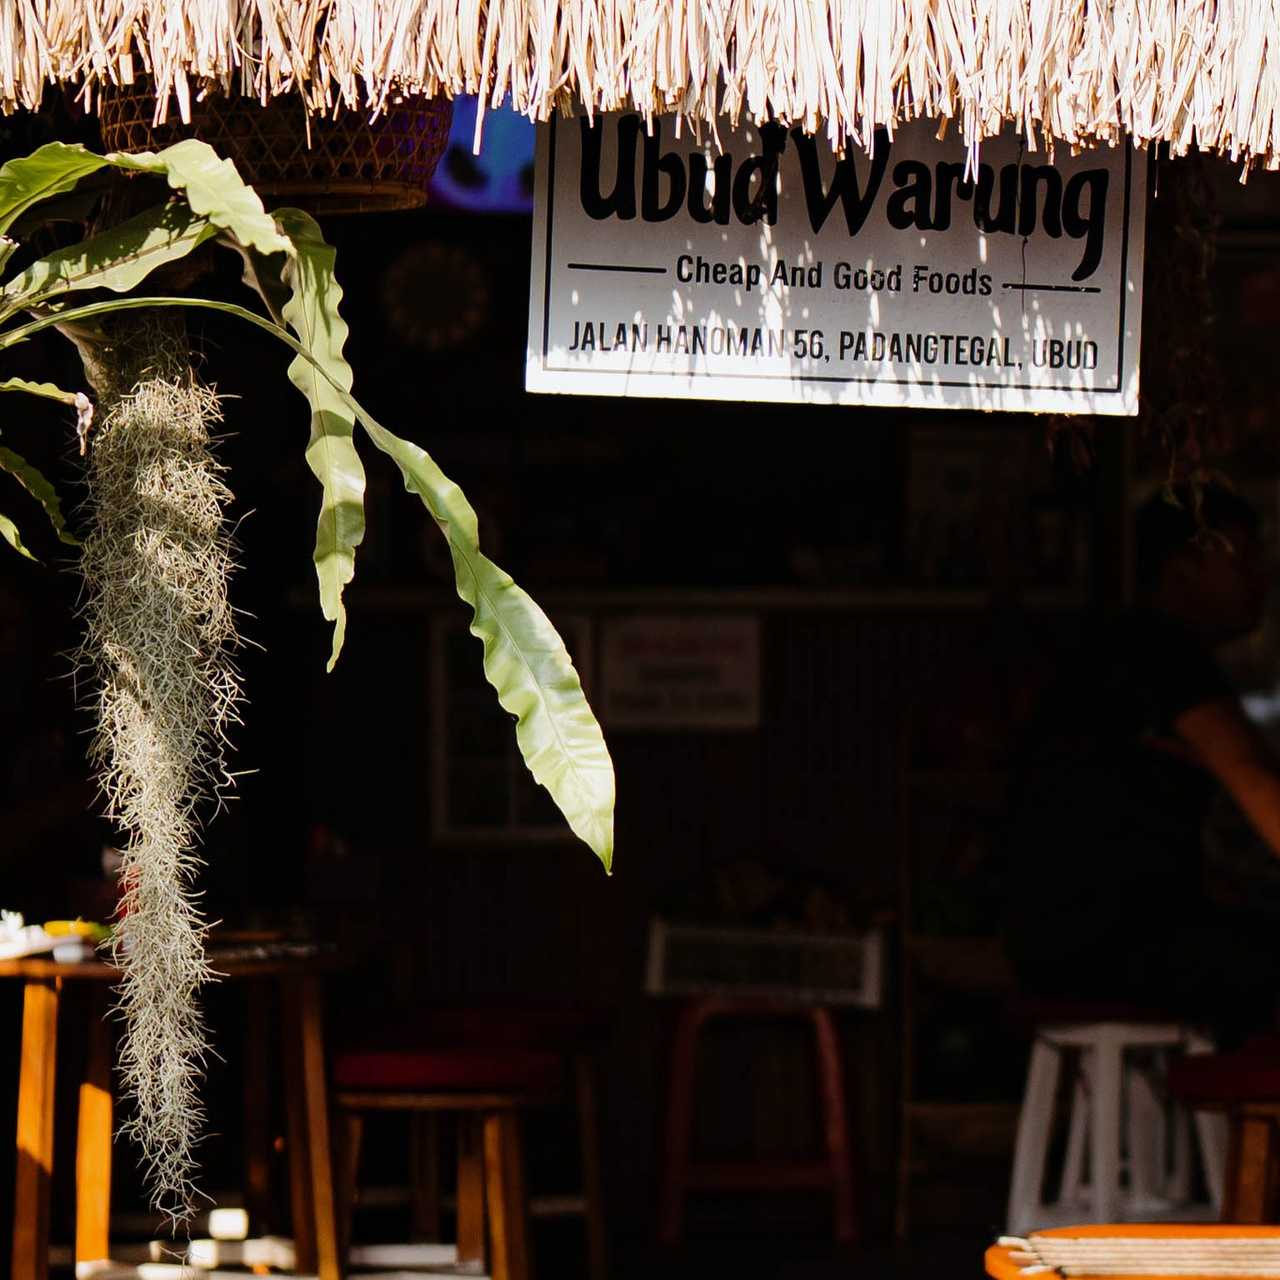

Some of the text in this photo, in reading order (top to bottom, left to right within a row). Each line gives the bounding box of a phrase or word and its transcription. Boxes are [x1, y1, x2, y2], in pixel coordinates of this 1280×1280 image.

[580, 114, 1109, 282] Ubud Warung
[676, 255, 993, 295] Cheap And Good Foods
[569, 321, 1098, 370] JALAN HANOMAN 56, PADANGTEGAL, UBUD
